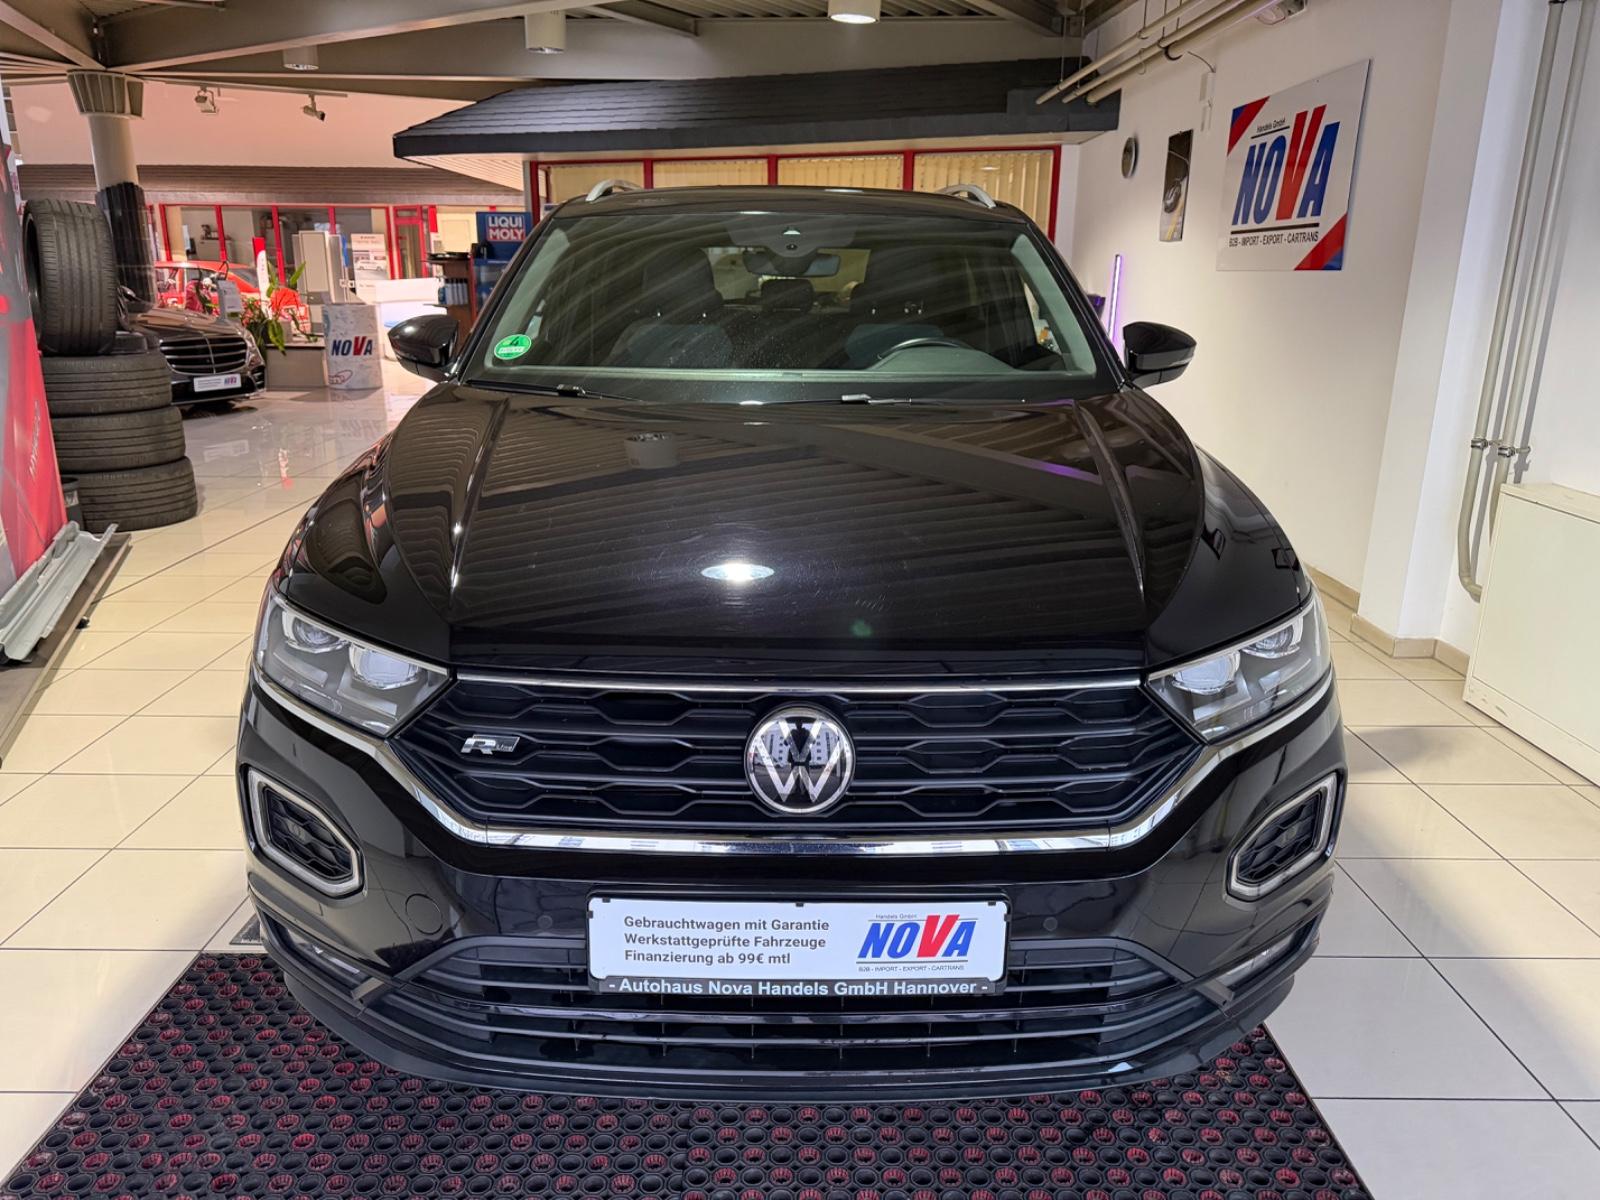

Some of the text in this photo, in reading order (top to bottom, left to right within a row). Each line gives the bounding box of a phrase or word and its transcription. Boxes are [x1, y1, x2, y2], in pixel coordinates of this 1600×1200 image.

[1231, 104, 1340, 225] NOVA
[488, 216, 522, 228] LIQUI
[489, 228, 523, 240] MOLY
[1263, 234, 1283, 245] EXPORT
[1287, 231, 1319, 244] CARTRANS
[331, 336, 373, 356] NOVA
[624, 916, 829, 932] Gebrauchtwagen mit Garantie
[624, 933, 826, 950] Werkstattgeprüfte Fahrzeuge
[857, 914, 977, 959] NOVA
[624, 950, 790, 966] Finanzierung ab 99€ mtl
[618, 978, 703, 993] Autohaus
[709, 981, 753, 995] Nova
[758, 981, 829, 995] Handels
[834, 982, 888, 995] GmbH
[893, 981, 977, 995] Hannover
